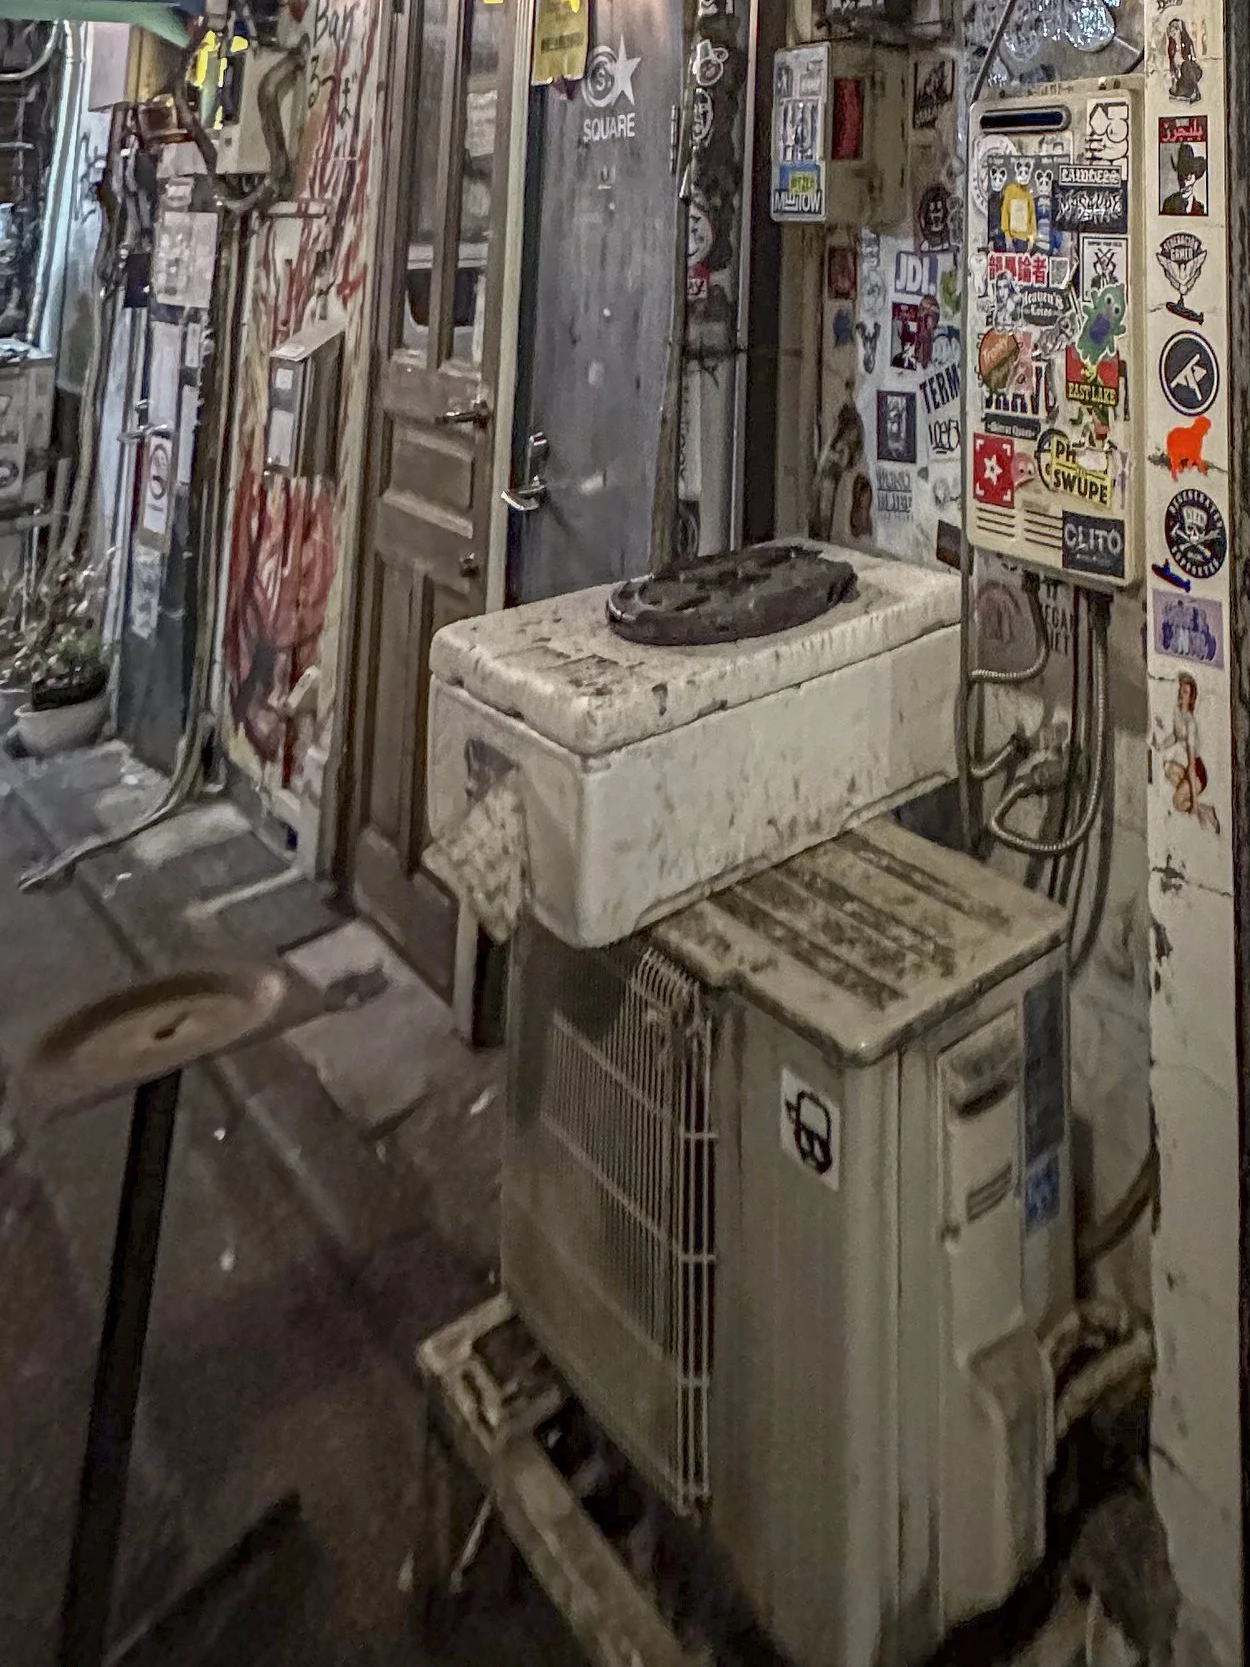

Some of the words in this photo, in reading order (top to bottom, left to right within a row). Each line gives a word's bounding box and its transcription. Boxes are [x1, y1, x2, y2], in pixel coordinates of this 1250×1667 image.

[583, 112, 636, 142] SQUARE
[1068, 382, 1091, 401] EAST
[1092, 387, 1117, 404] LAKE
